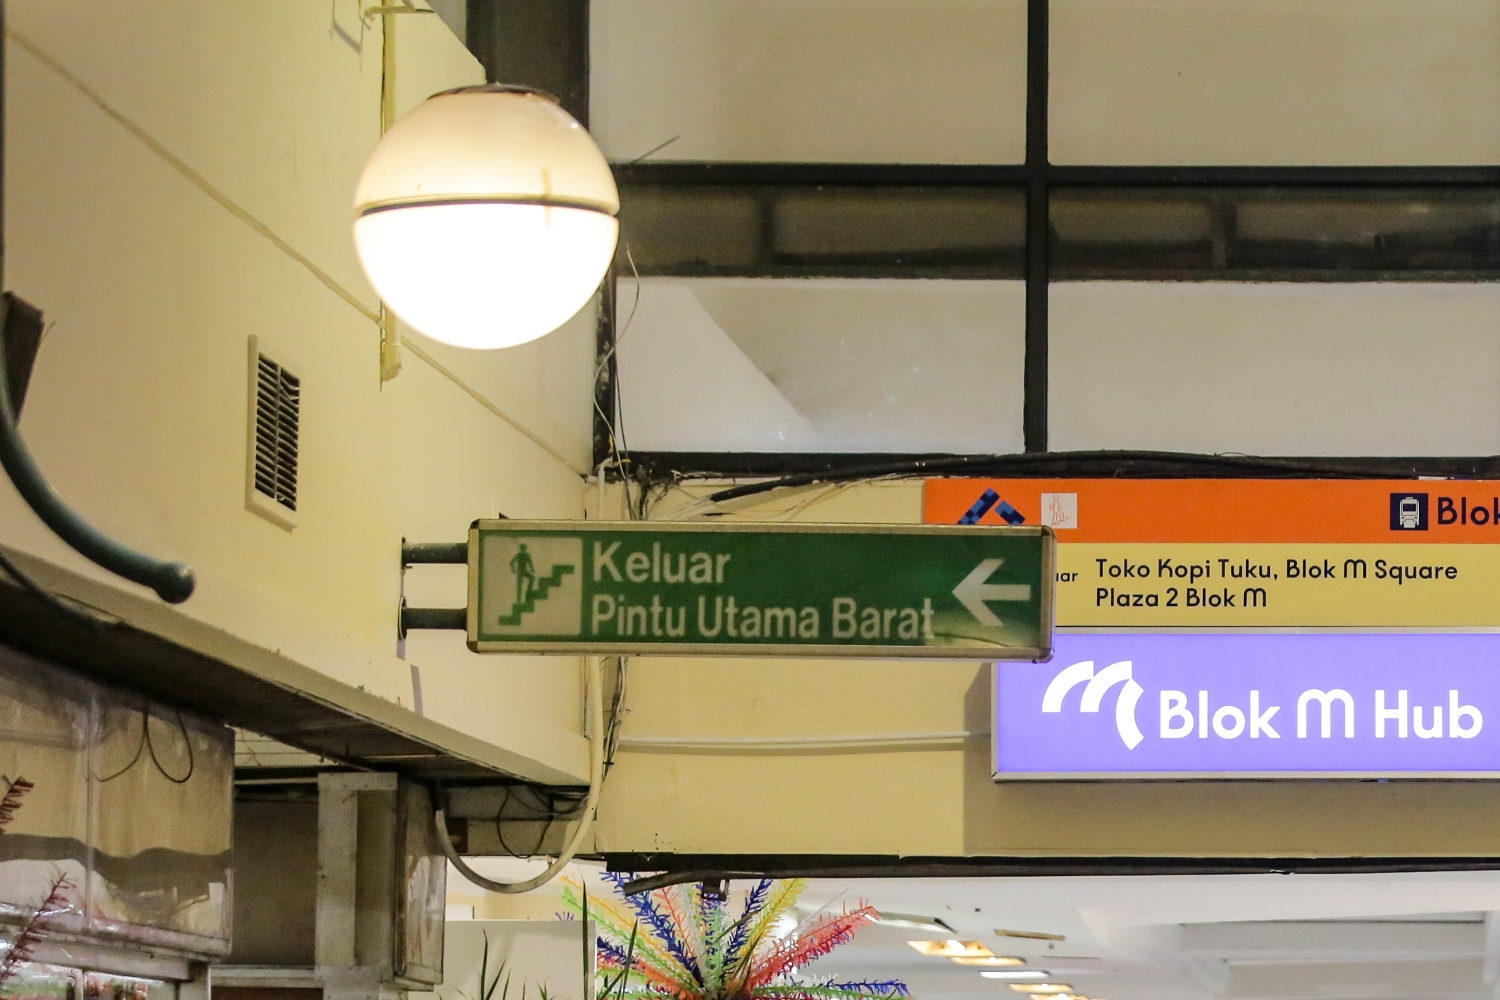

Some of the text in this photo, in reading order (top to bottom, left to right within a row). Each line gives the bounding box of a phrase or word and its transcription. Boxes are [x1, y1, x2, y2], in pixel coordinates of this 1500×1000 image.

[593, 541, 730, 584] Keluar
[1095, 558, 1458, 586] Toko Kopi Tuku, Blok M Square
[592, 594, 935, 640] Pintu Utama Barat
[1096, 587, 1267, 608] Plaza 2 Blok M
[1159, 689, 1484, 739] Blok M Hub
